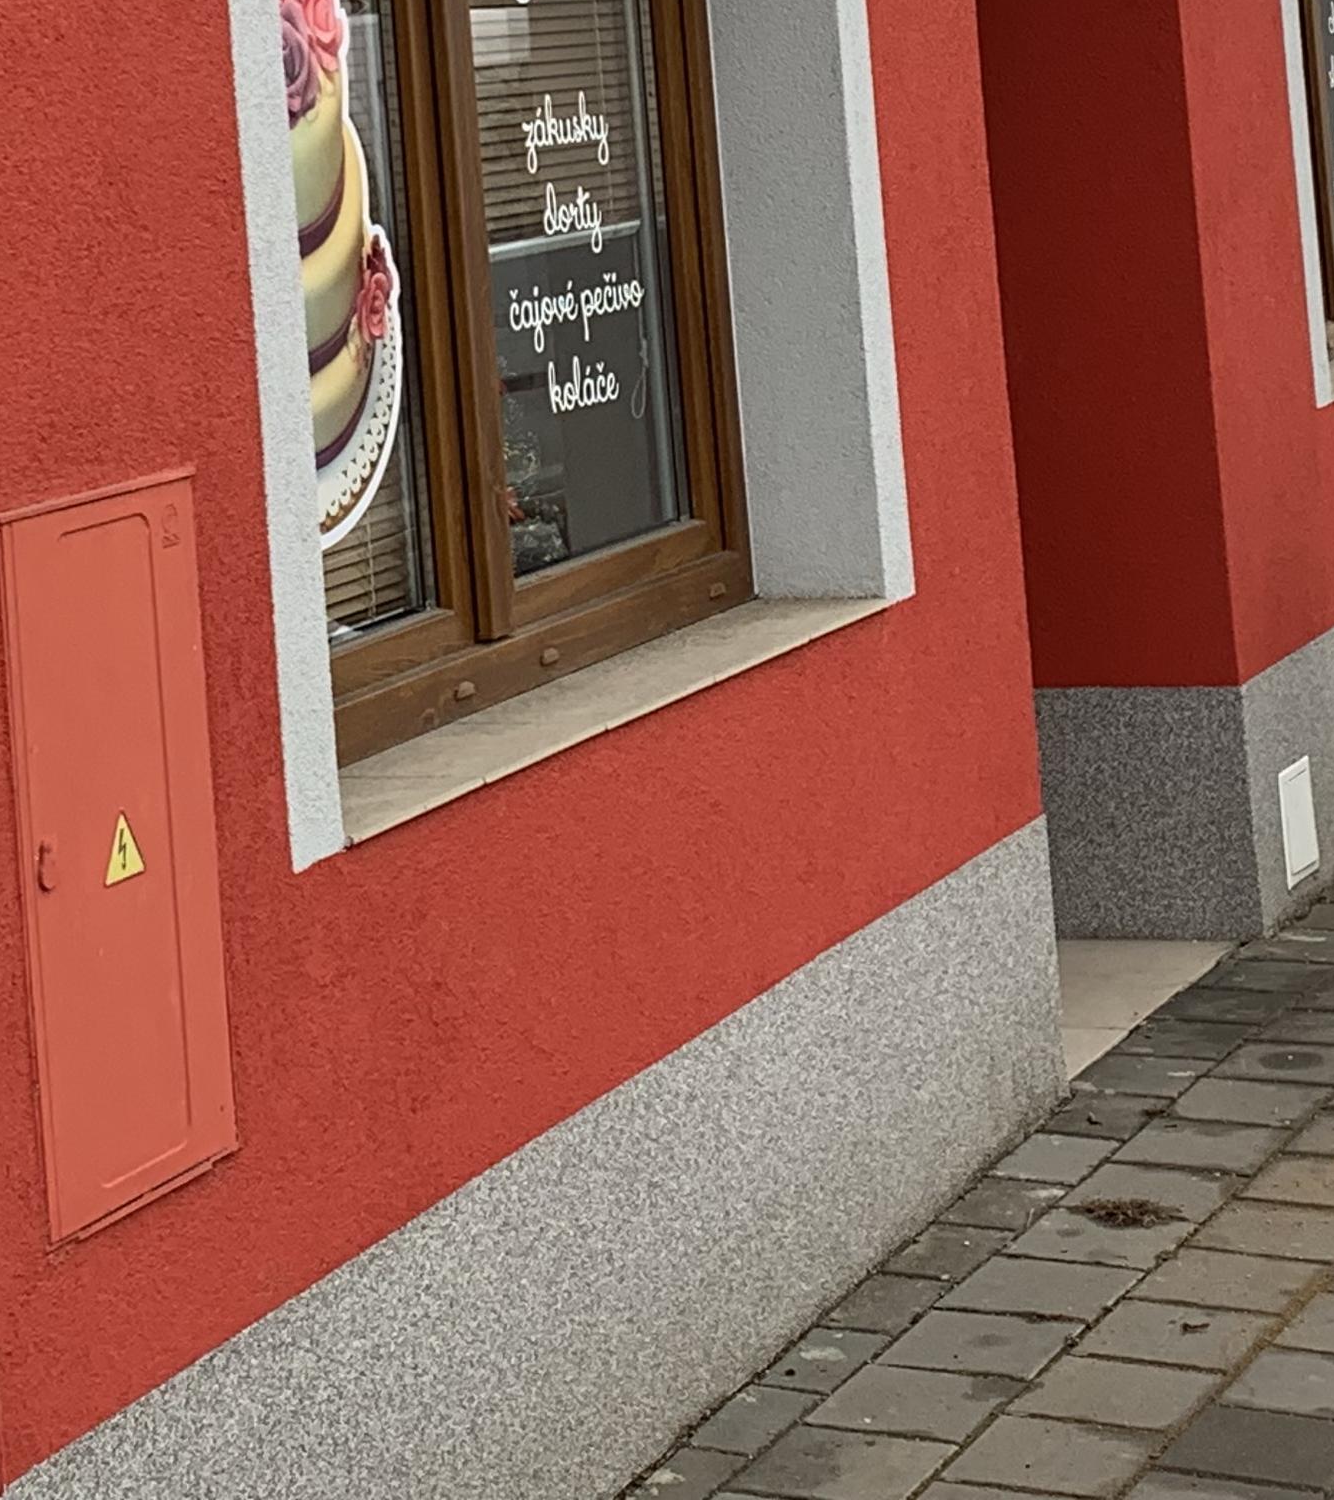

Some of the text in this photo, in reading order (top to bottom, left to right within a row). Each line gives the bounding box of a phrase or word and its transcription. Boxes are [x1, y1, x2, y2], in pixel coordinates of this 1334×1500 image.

[522, 90, 610, 174] zákusky
[543, 182, 602, 254] dorty
[509, 272, 645, 353] čajové pečivo
[548, 356, 619, 414] koláče
